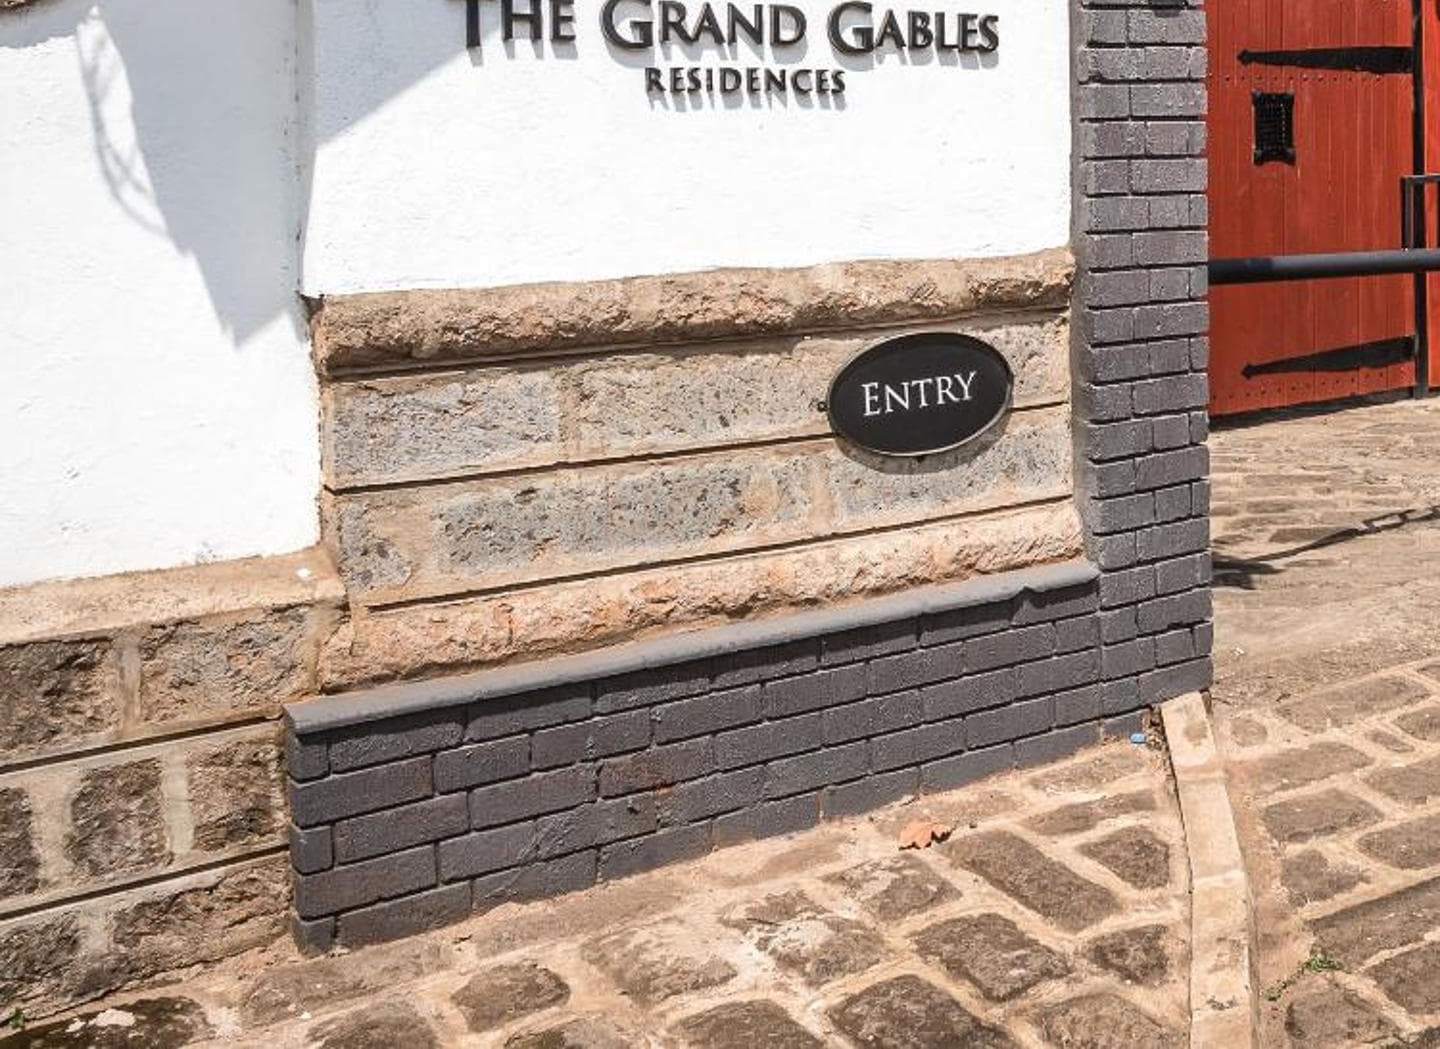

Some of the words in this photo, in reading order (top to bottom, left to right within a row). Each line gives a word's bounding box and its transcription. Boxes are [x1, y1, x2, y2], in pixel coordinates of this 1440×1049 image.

[828, 0, 997, 54] GABLES
[645, 67, 847, 94] RESIDENCES
[861, 370, 977, 417] ENTRY
